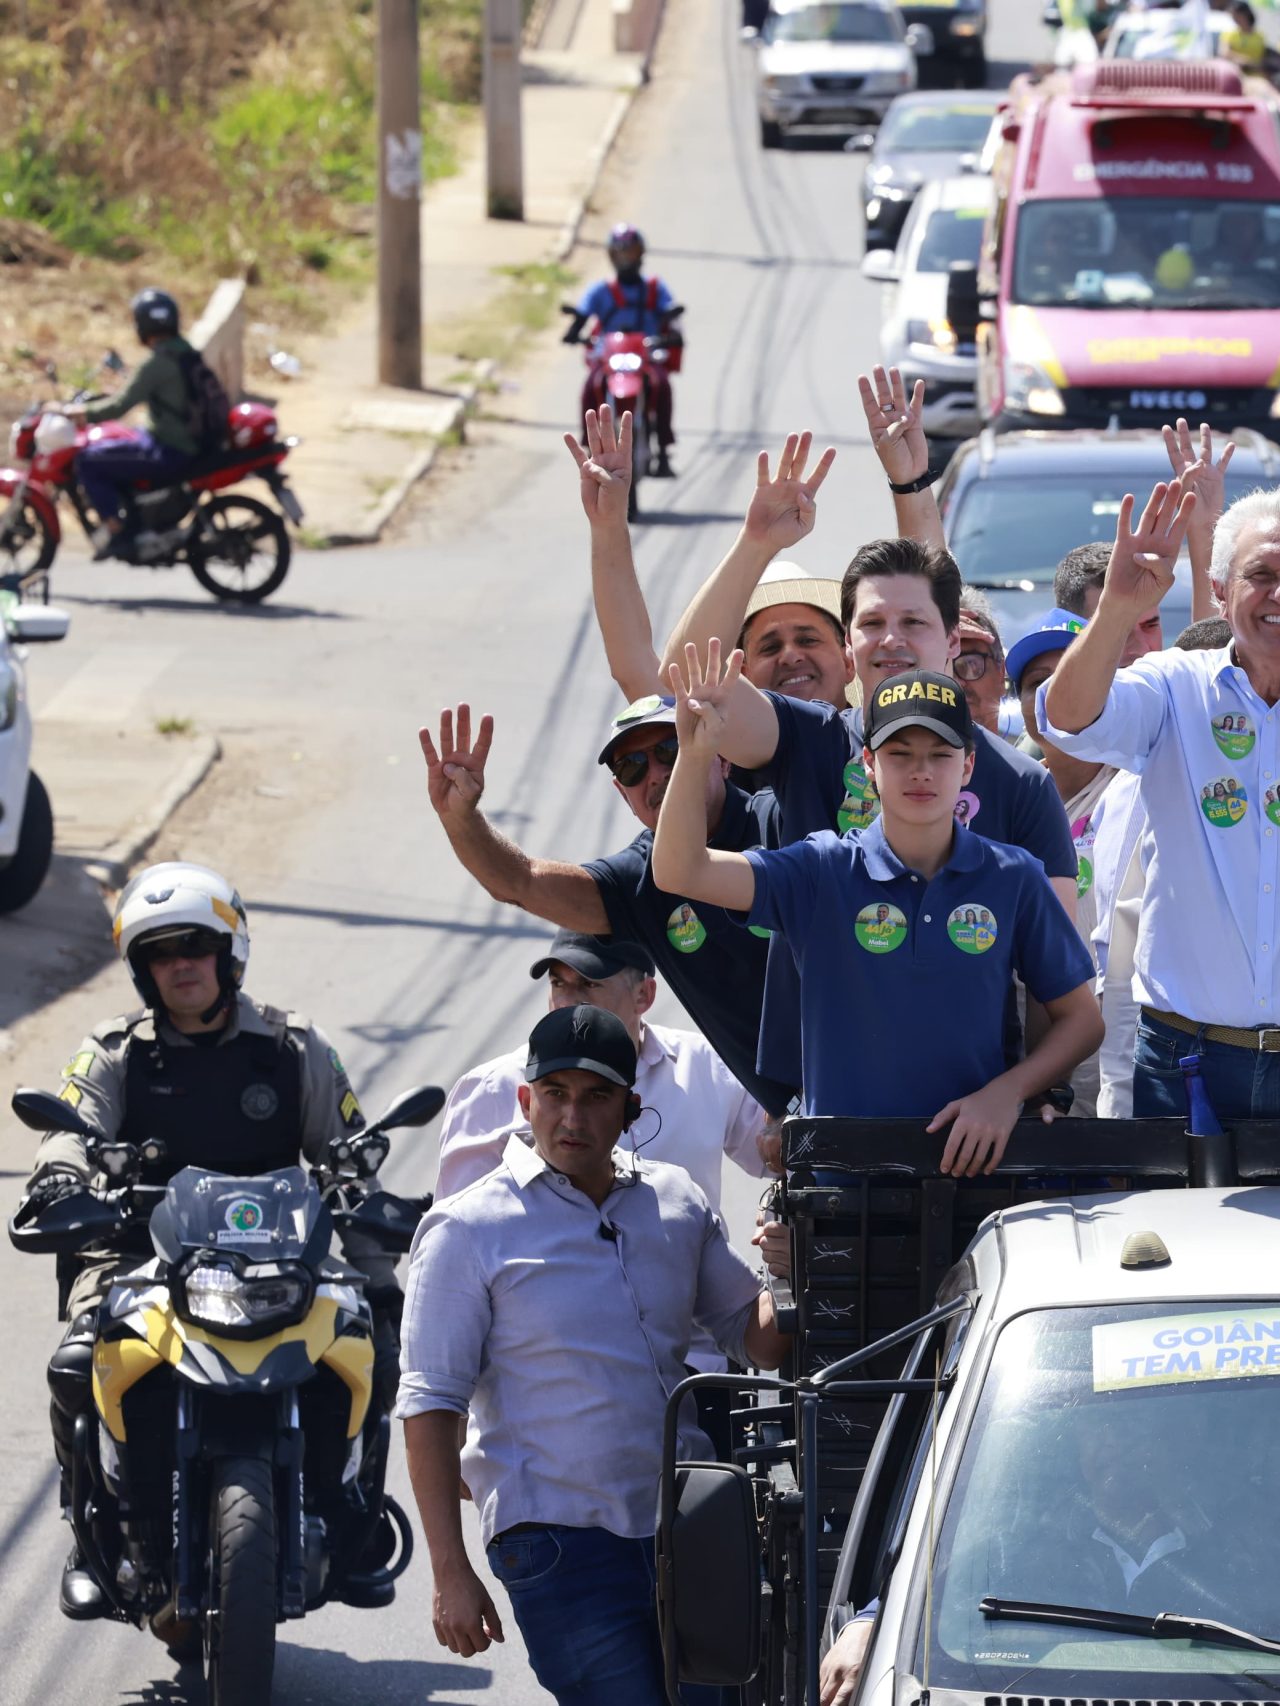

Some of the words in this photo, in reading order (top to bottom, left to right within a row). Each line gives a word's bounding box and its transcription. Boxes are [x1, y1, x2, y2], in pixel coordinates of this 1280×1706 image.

[1130, 391, 1206, 409] IVECO
[878, 682, 956, 707] GRAER
[1121, 1351, 1202, 1378] TEM
